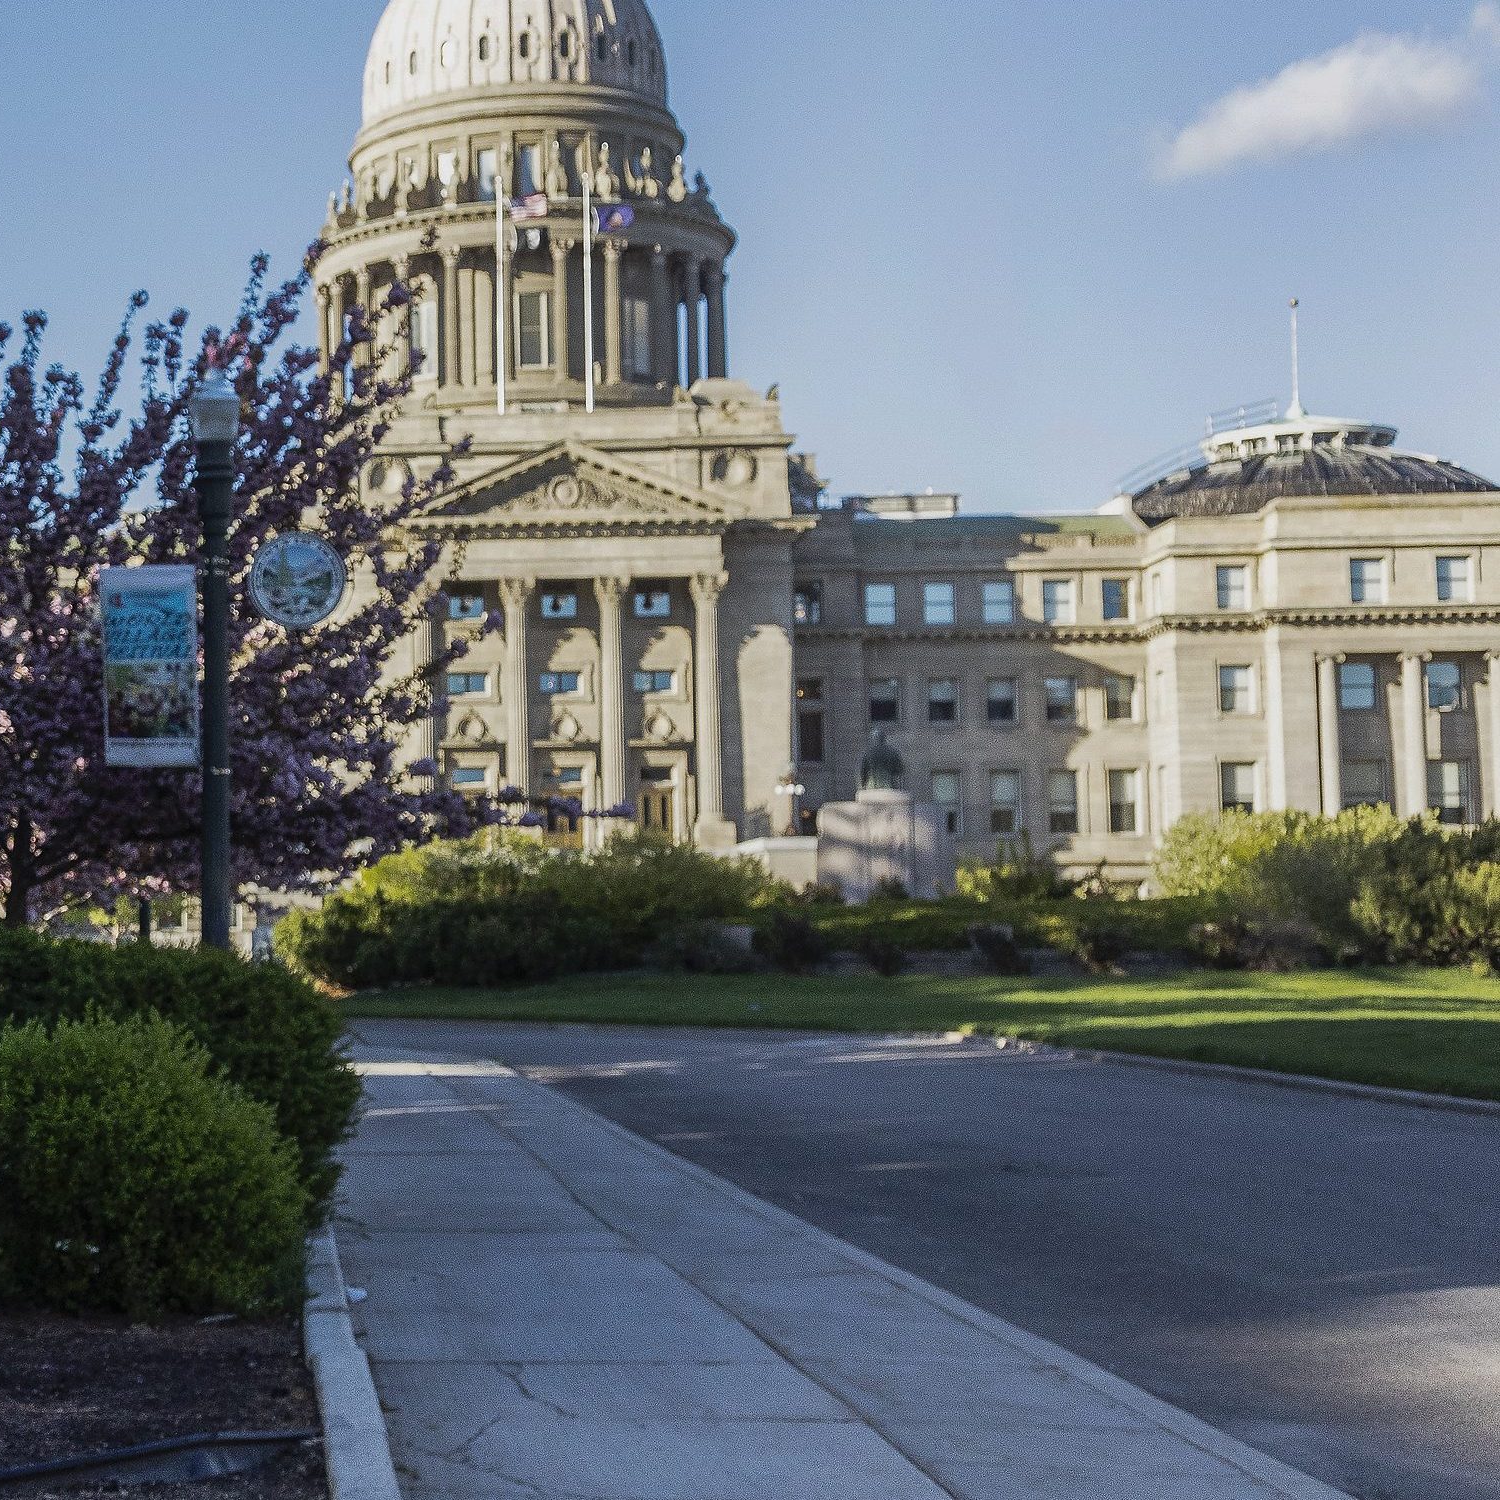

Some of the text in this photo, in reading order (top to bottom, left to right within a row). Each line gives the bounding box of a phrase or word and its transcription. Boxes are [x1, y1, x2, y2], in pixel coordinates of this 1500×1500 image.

[103, 610, 191, 627] WORLD
[104, 626, 191, 642] VILLAGE
[103, 643, 192, 659] FESTIVAL
